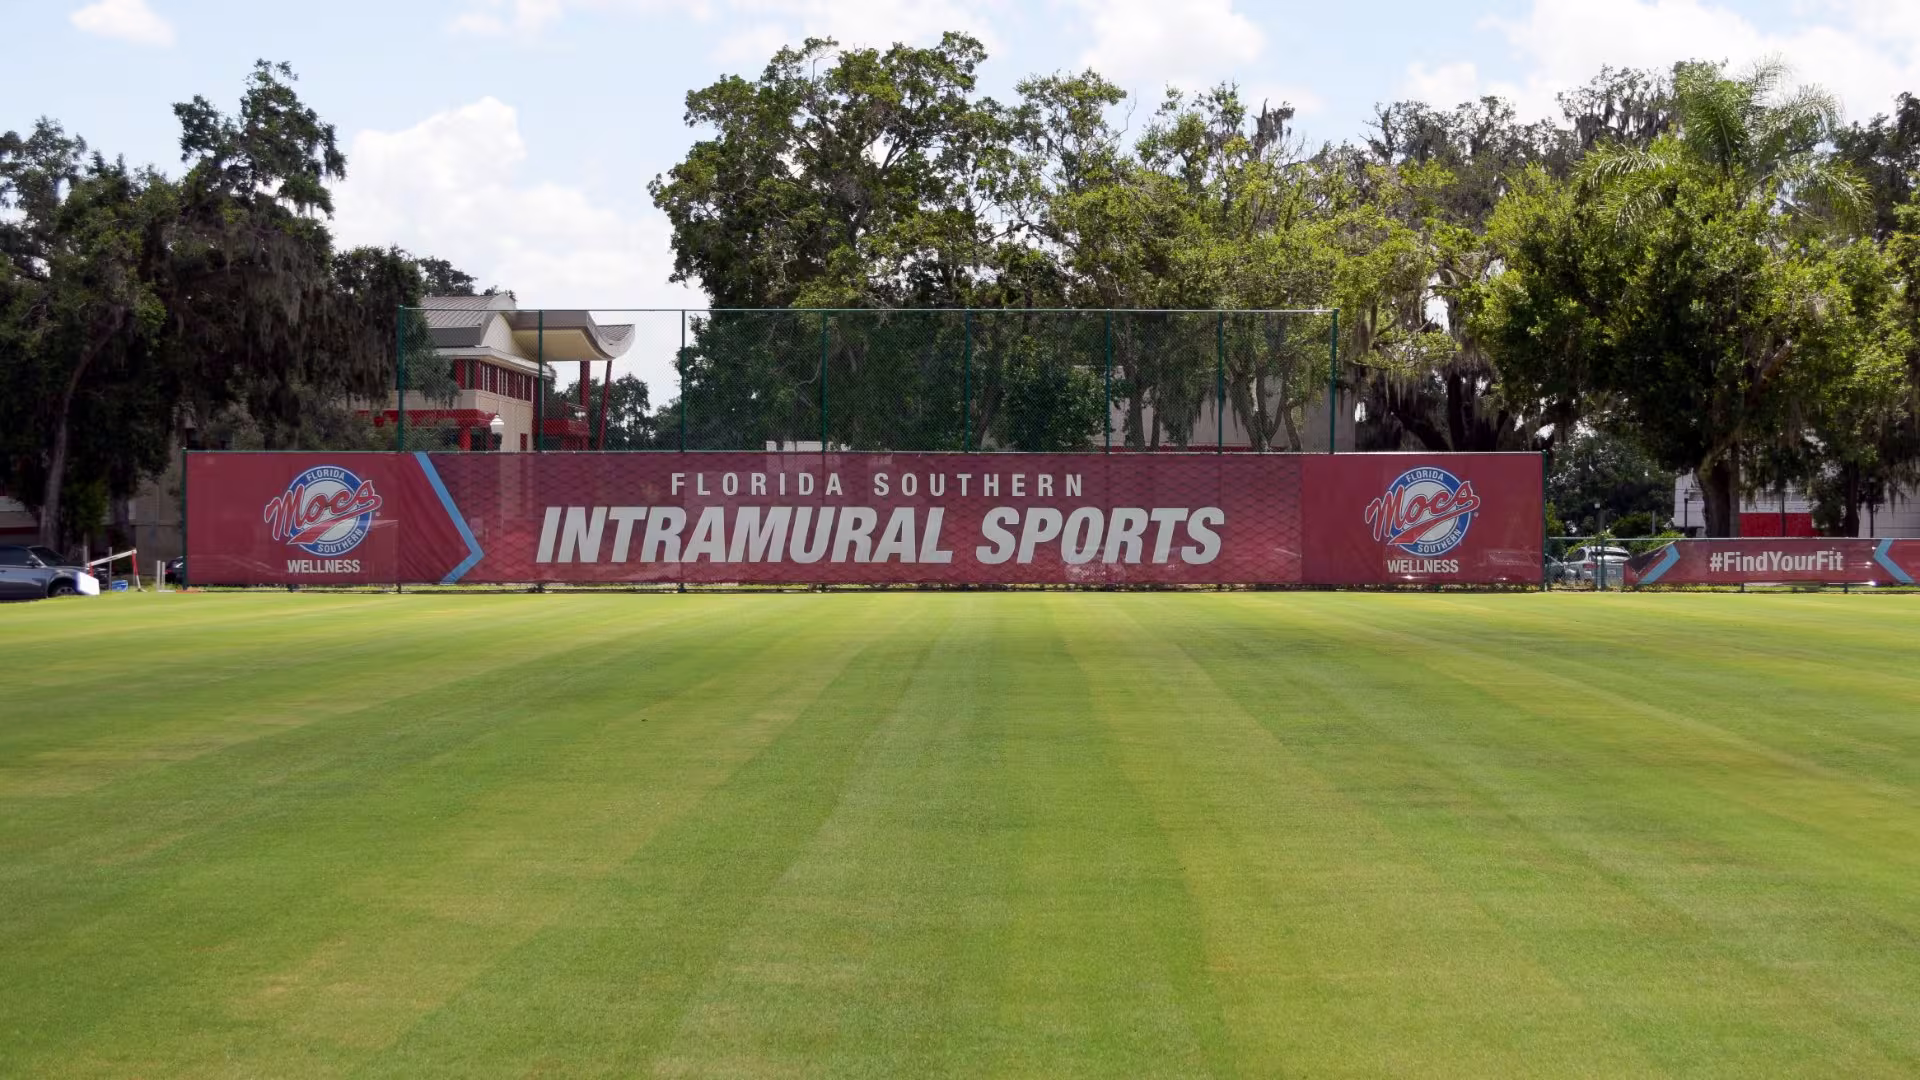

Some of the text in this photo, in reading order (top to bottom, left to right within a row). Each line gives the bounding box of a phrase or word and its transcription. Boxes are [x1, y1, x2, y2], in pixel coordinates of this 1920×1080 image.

[306, 468, 345, 481] FLORIDA
[671, 472, 1083, 496] FLORIDA SOUTHERN
[1406, 469, 1444, 482] FLORIDA
[264, 480, 383, 545] Mocs
[1364, 480, 1481, 545] Mocs
[318, 528, 363, 553] SOUTHERN
[535, 506, 1225, 565] INTRAMURAL SPORTS
[1417, 528, 1461, 553] SOUTHERN
[287, 559, 361, 573] WELLNESS
[1387, 559, 1459, 573] WELLNESS
[1709, 550, 1843, 572] #FindYourFit
